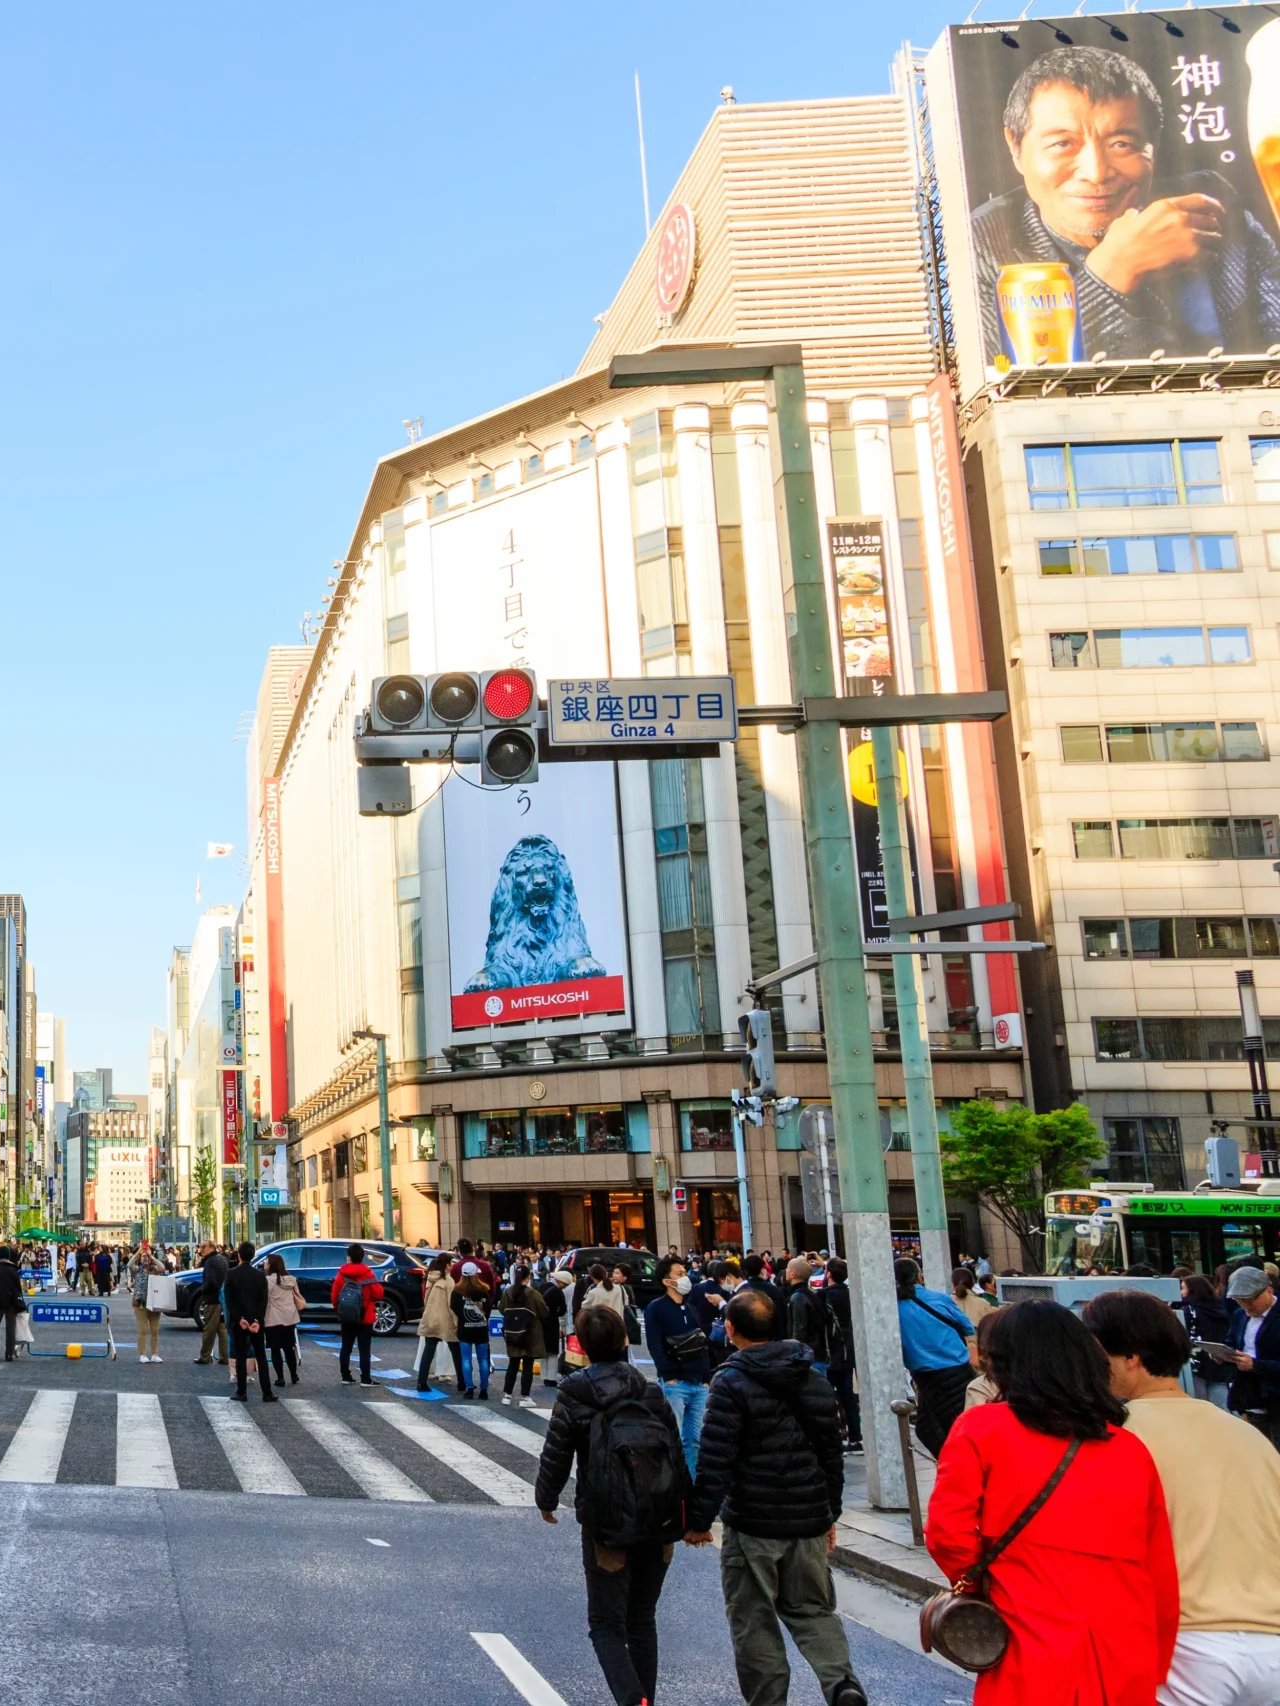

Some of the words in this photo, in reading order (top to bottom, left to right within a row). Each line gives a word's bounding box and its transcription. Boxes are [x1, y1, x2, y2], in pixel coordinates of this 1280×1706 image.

[1171, 54, 1236, 163] 神泡。
[1000, 292, 1075, 312] PREMIUM
[928, 390, 956, 556] MITSUKOSHI
[832, 545, 882, 555] レストランフロア
[559, 680, 611, 694] 中央区
[560, 693, 723, 722] 銀座四丁目
[610, 723, 657, 737] Ginza
[664, 724, 675, 737] 4
[266, 783, 280, 874] MITSUKOSHI
[510, 990, 589, 1009] MITSUKOSHI
[226, 1080, 236, 1140] 三菱UFJ銀行
[111, 1152, 141, 1162] LIXIL
[1142, 1201, 1187, 1213] 都営バス
[1220, 1203, 1243, 1213] NON
[1245, 1203, 1271, 1213] STEP
